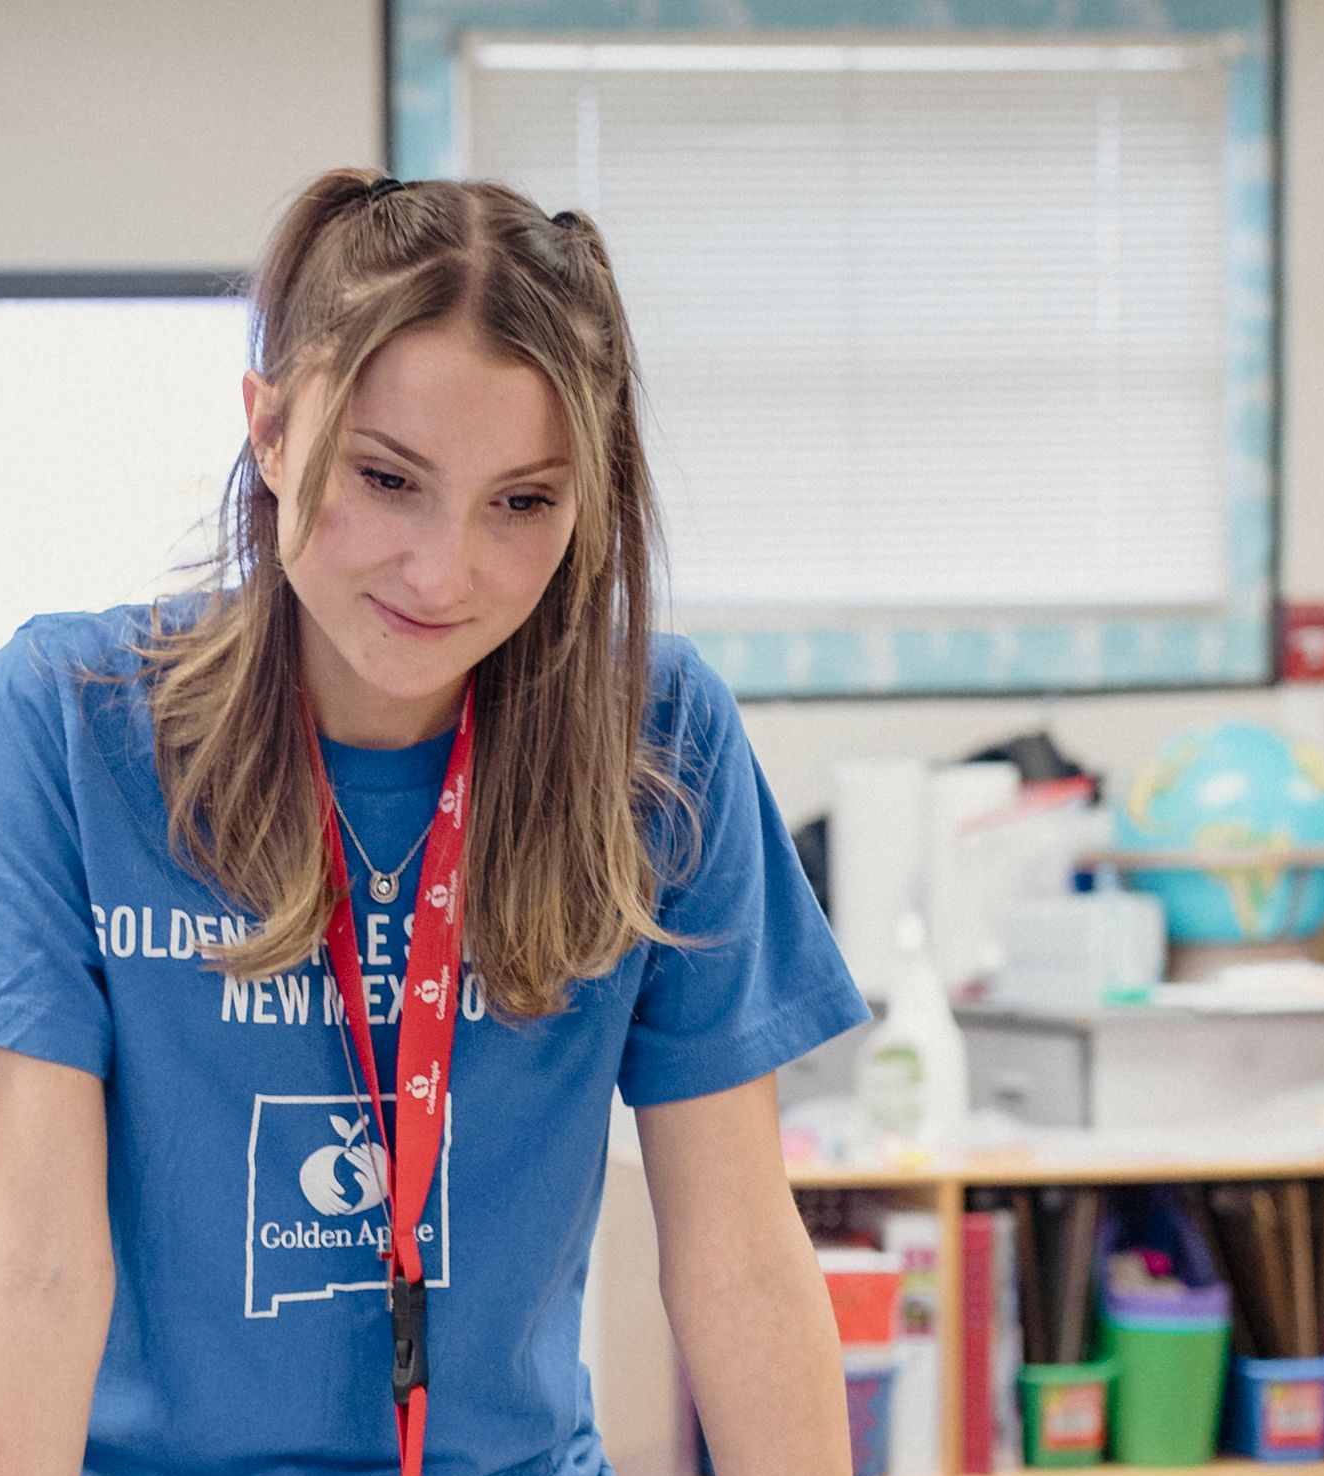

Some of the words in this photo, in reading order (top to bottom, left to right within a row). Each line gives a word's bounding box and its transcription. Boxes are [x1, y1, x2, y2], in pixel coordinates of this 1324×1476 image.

[438, 964, 451, 989] Apple
[221, 974, 310, 1026] NEW
[323, 973, 486, 1026] MEXO
[435, 990, 447, 1020] Golden
[429, 1060, 441, 1085] Apple
[426, 1085, 438, 1115] Golden
[260, 1221, 353, 1250] Golden
[356, 1219, 434, 1255] Ape
